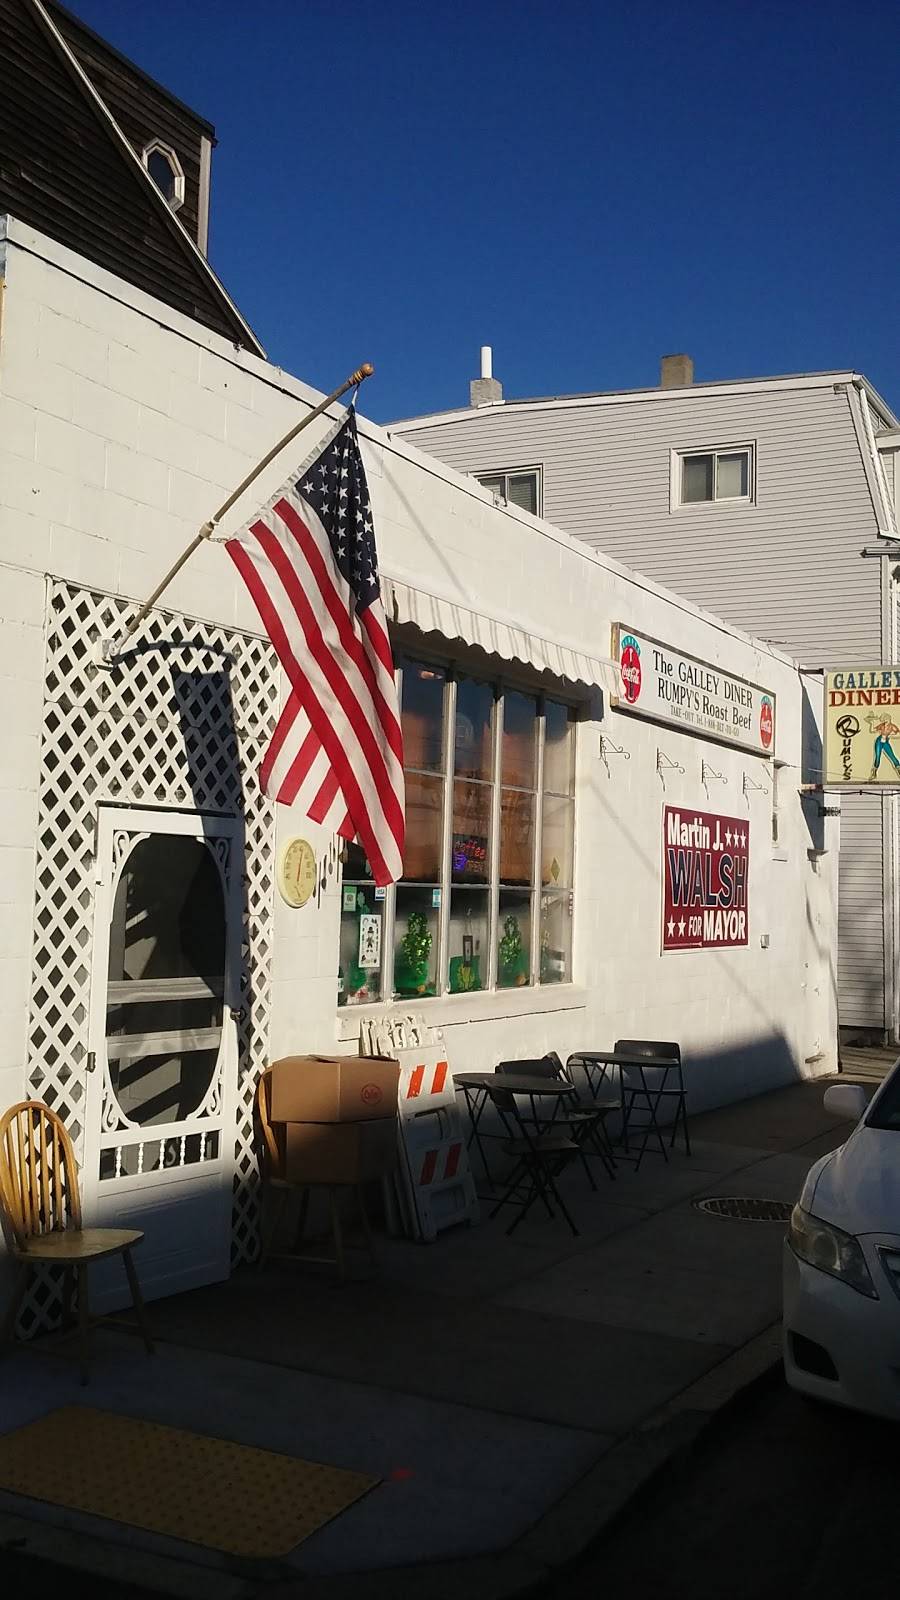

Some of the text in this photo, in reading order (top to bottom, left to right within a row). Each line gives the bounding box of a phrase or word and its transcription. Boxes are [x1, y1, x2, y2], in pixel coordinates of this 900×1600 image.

[653, 649, 753, 709] The GALLEY DINER
[658, 677, 752, 731] RUMPY'S Roast Beef
[667, 812, 724, 851] Martin J.
[667, 848, 747, 908] WALSH
[688, 910, 746, 941] FOR MAYOR
